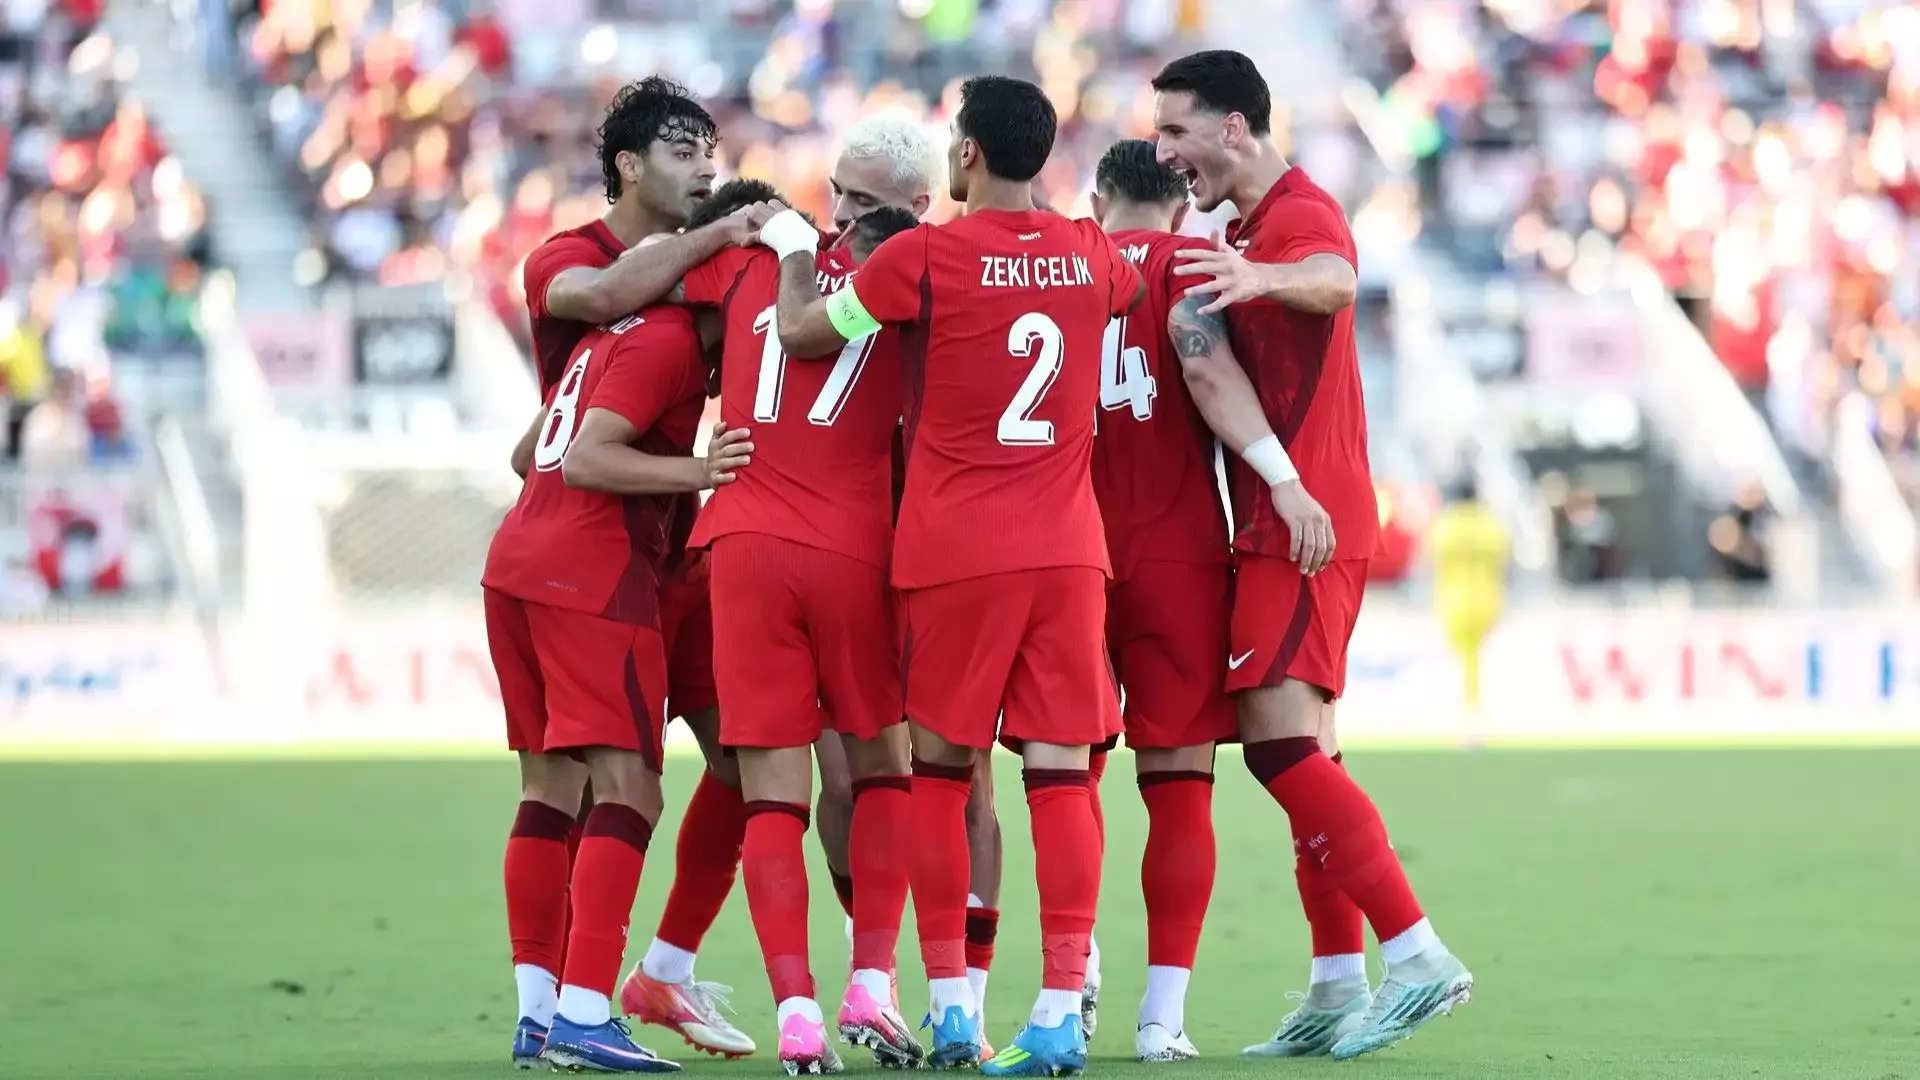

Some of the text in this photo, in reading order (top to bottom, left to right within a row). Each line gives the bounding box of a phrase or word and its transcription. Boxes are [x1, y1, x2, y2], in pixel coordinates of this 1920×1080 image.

[980, 251, 1095, 290] ZEKİ ÇELİK
[534, 348, 593, 472] 8
[753, 304, 877, 427] 17
[997, 312, 1064, 446] 2
[1093, 316, 1157, 436] 4
